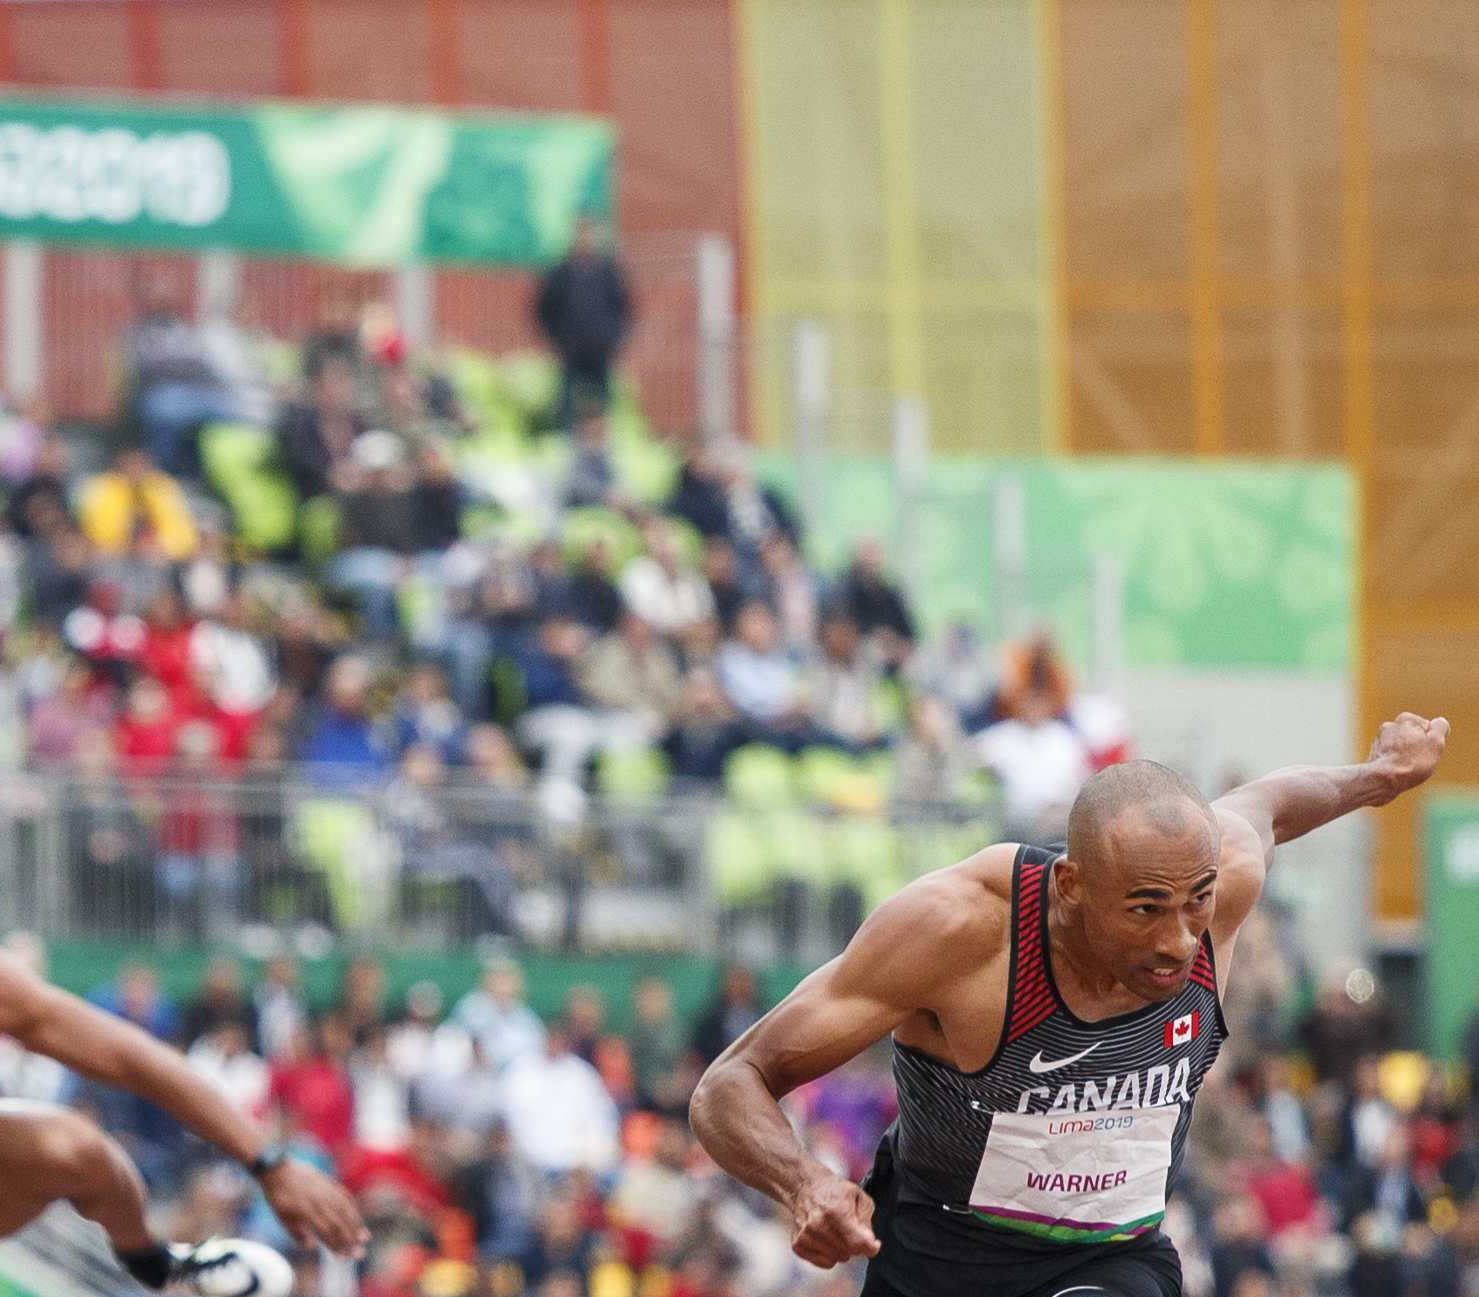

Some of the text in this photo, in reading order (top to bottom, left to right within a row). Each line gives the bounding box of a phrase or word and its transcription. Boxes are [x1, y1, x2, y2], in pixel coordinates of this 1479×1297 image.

[1017, 1057, 1191, 1117] CANADA
[1048, 1115, 1134, 1136] Lima2019
[1027, 1169, 1128, 1193] WARNER
